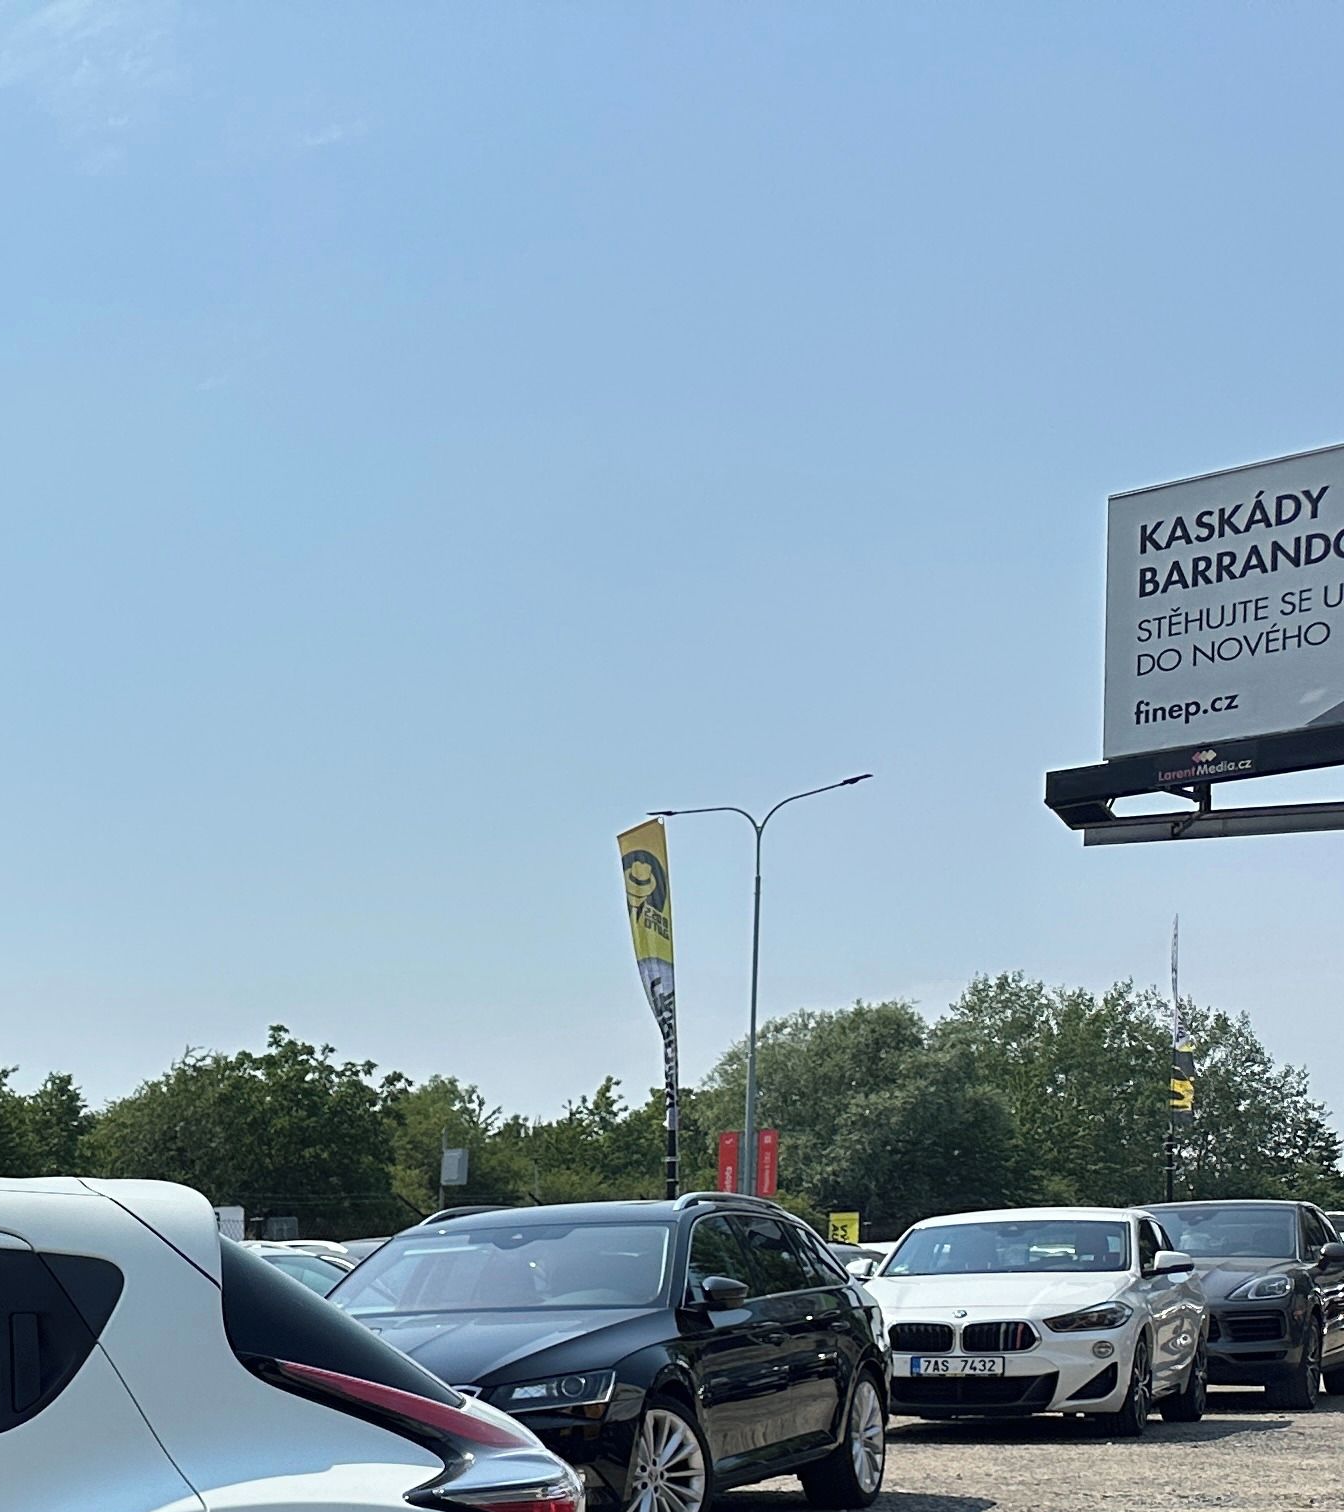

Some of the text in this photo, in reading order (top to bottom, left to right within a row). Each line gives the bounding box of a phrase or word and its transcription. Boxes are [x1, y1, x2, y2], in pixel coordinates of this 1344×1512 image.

[1139, 485, 1330, 555] KASKÁDY
[1137, 597, 1269, 643] STĚHUJTE
[1280, 588, 1313, 617] SE
[1137, 622, 1331, 676] DO NOVÉHO
[1134, 694, 1239, 725] finep.cz
[1158, 760, 1252, 781] LarentMedia.cz
[923, 1359, 996, 1372] 7AS 7432
